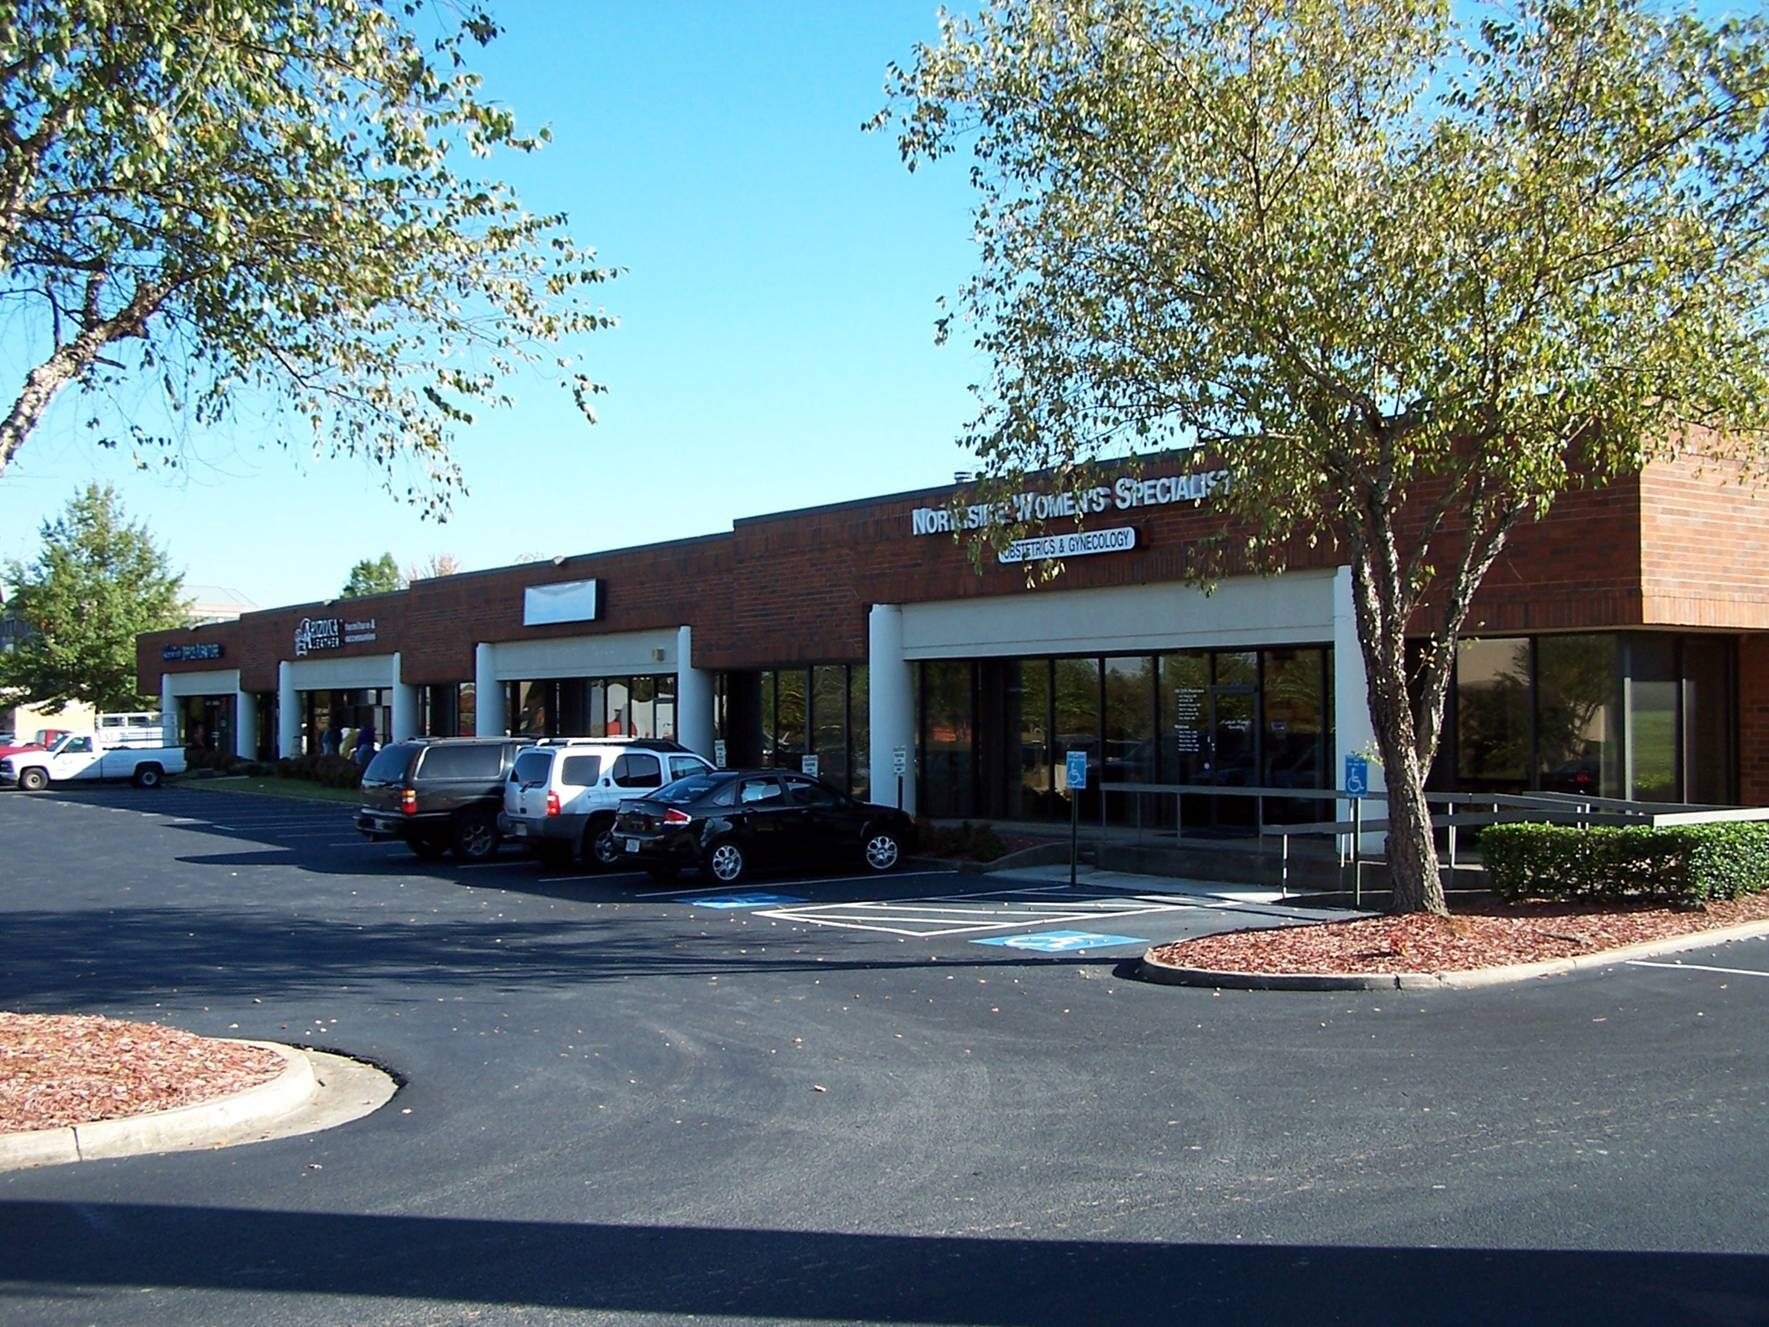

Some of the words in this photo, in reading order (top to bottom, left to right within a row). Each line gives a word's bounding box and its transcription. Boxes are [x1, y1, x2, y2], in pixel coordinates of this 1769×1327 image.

[912, 500, 1012, 535] NORTSIE
[1058, 538, 1065, 554] &
[1068, 530, 1129, 552] GYNECOLOGY
